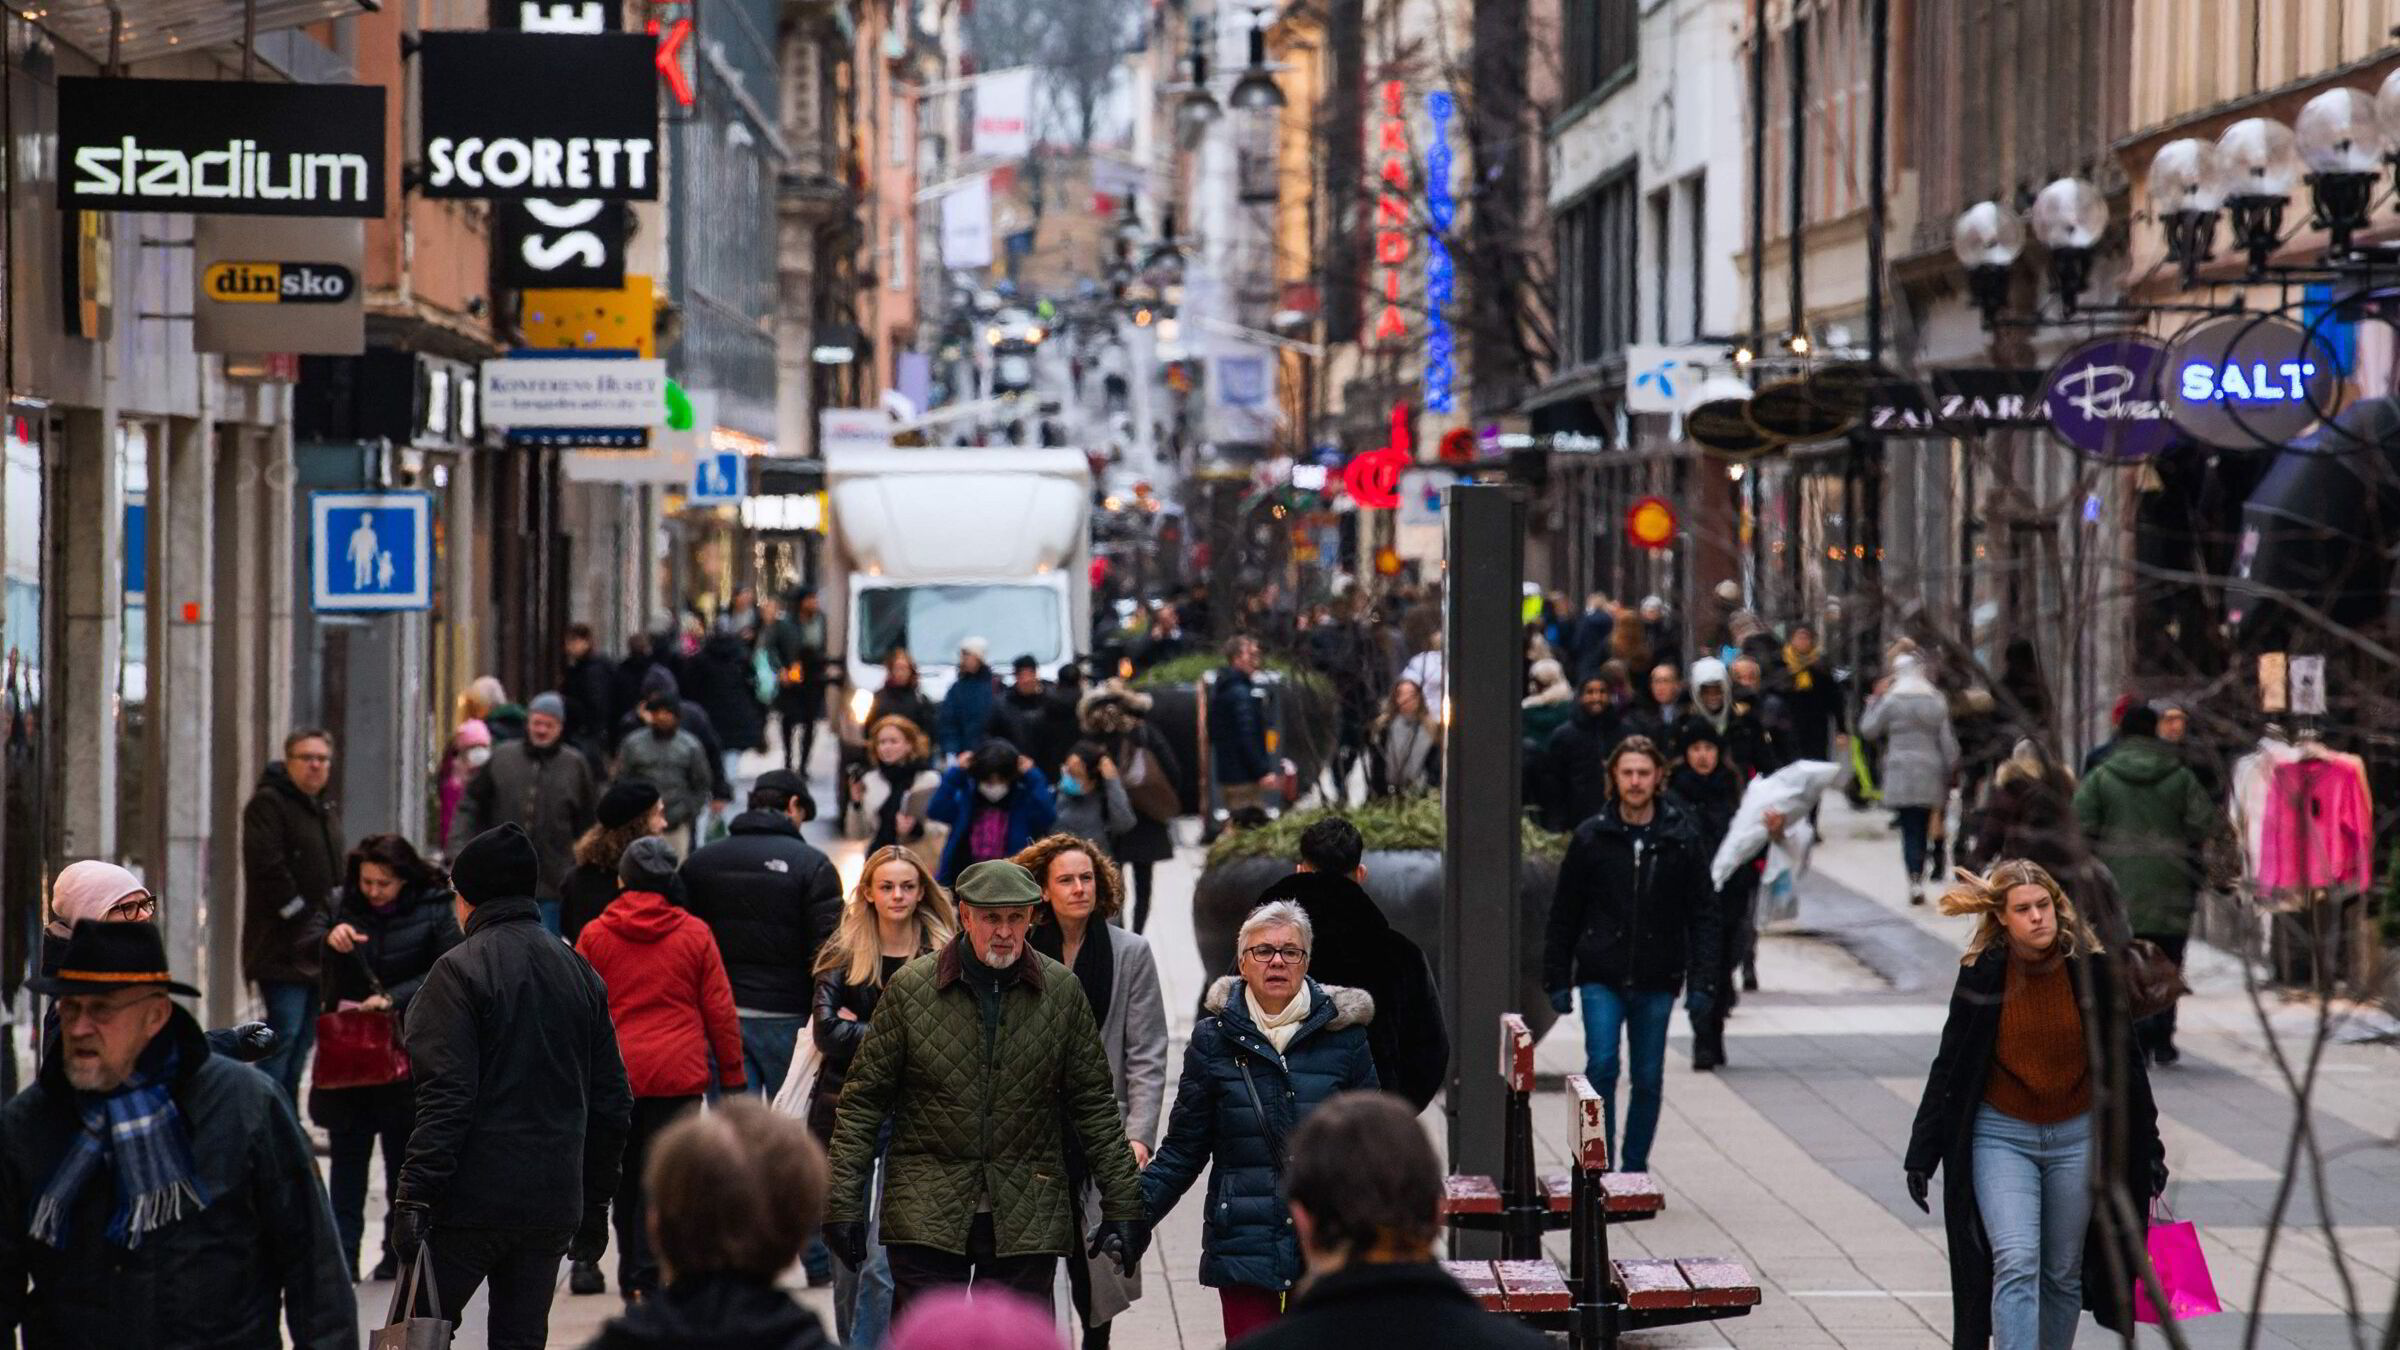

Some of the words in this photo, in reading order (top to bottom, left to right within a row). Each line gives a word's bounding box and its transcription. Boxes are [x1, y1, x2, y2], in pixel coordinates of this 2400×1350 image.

[73, 136, 368, 202] stadium
[428, 137, 652, 189] SCORETT
[217, 266, 344, 296] dinsko
[2182, 363, 2316, 400] SALT
